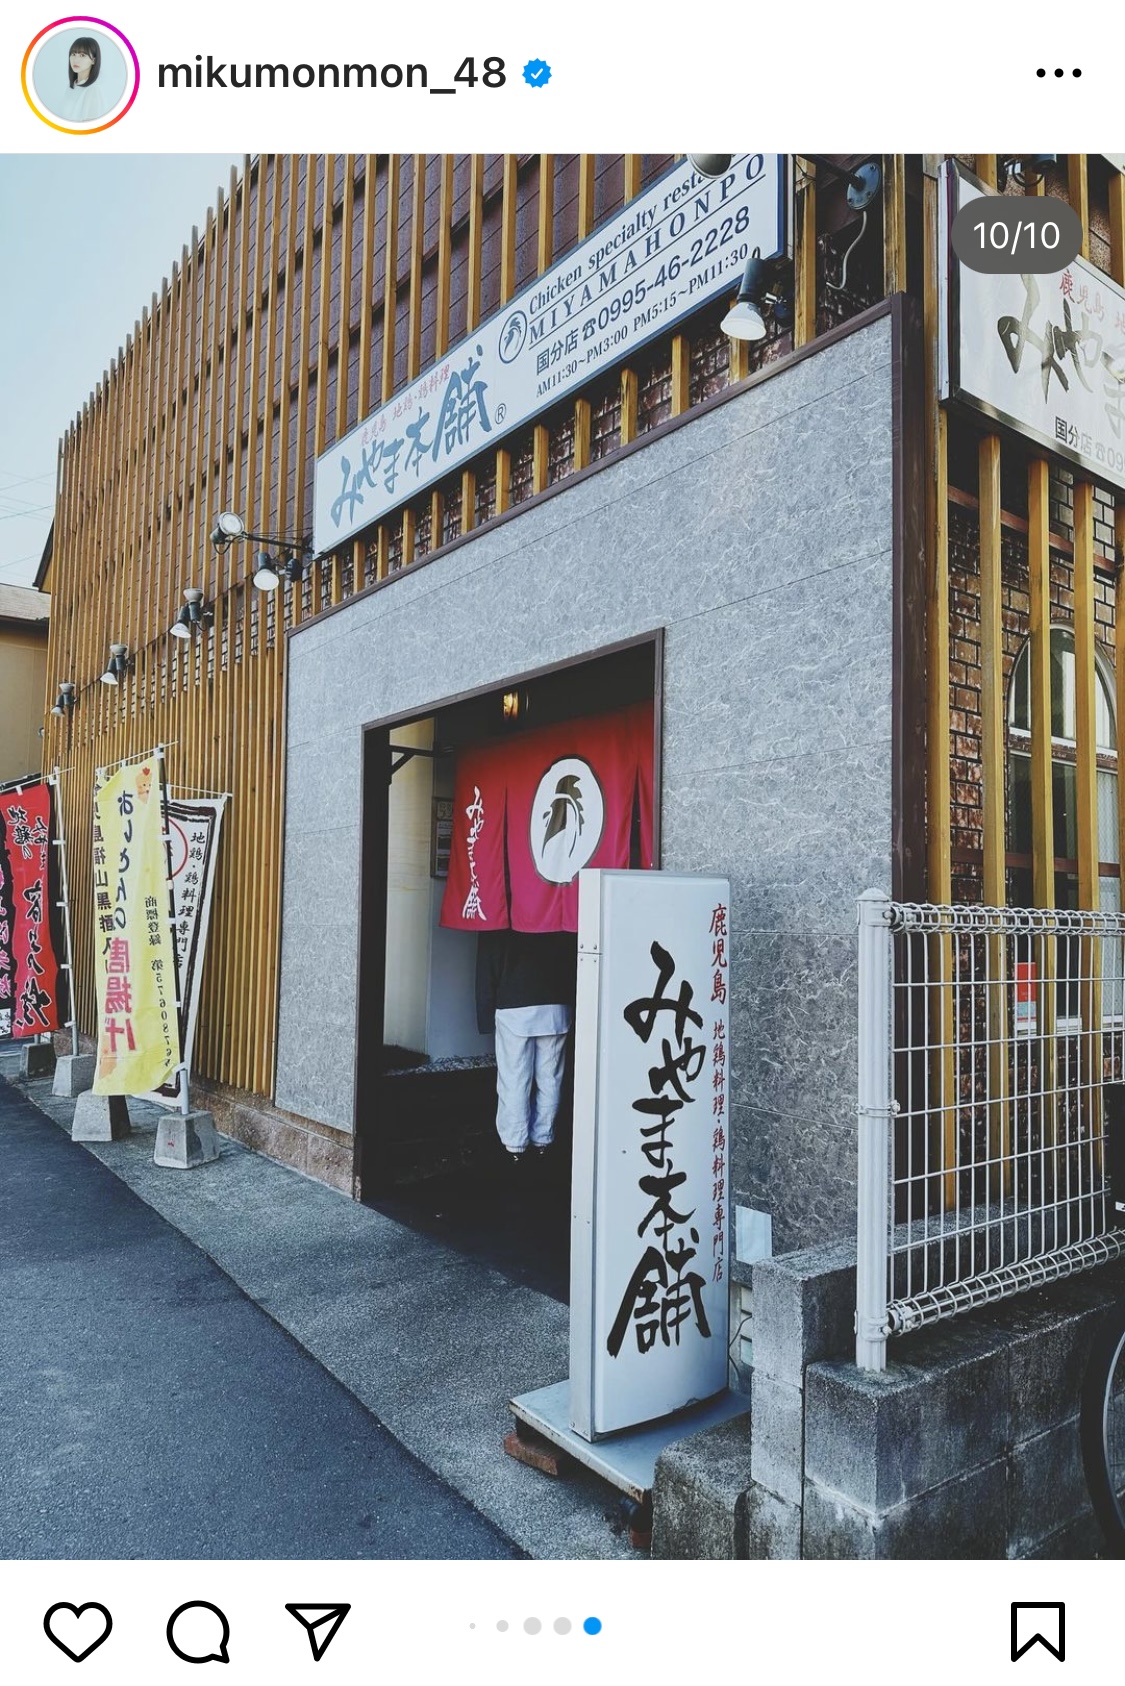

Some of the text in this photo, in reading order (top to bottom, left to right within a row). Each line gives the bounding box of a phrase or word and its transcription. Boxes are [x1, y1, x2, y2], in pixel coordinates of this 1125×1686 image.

[529, 170, 706, 315] Chicken specialty rest
[536, 205, 750, 376] 国分店 0995-46-2228
[330, 344, 492, 528] みやま本舗
[1055, 415, 1093, 457] 国分店
[607, 940, 711, 1359] みやま本舗
[708, 902, 728, 1283] 鹿児島 地鶏料理・鶏料理専門店
